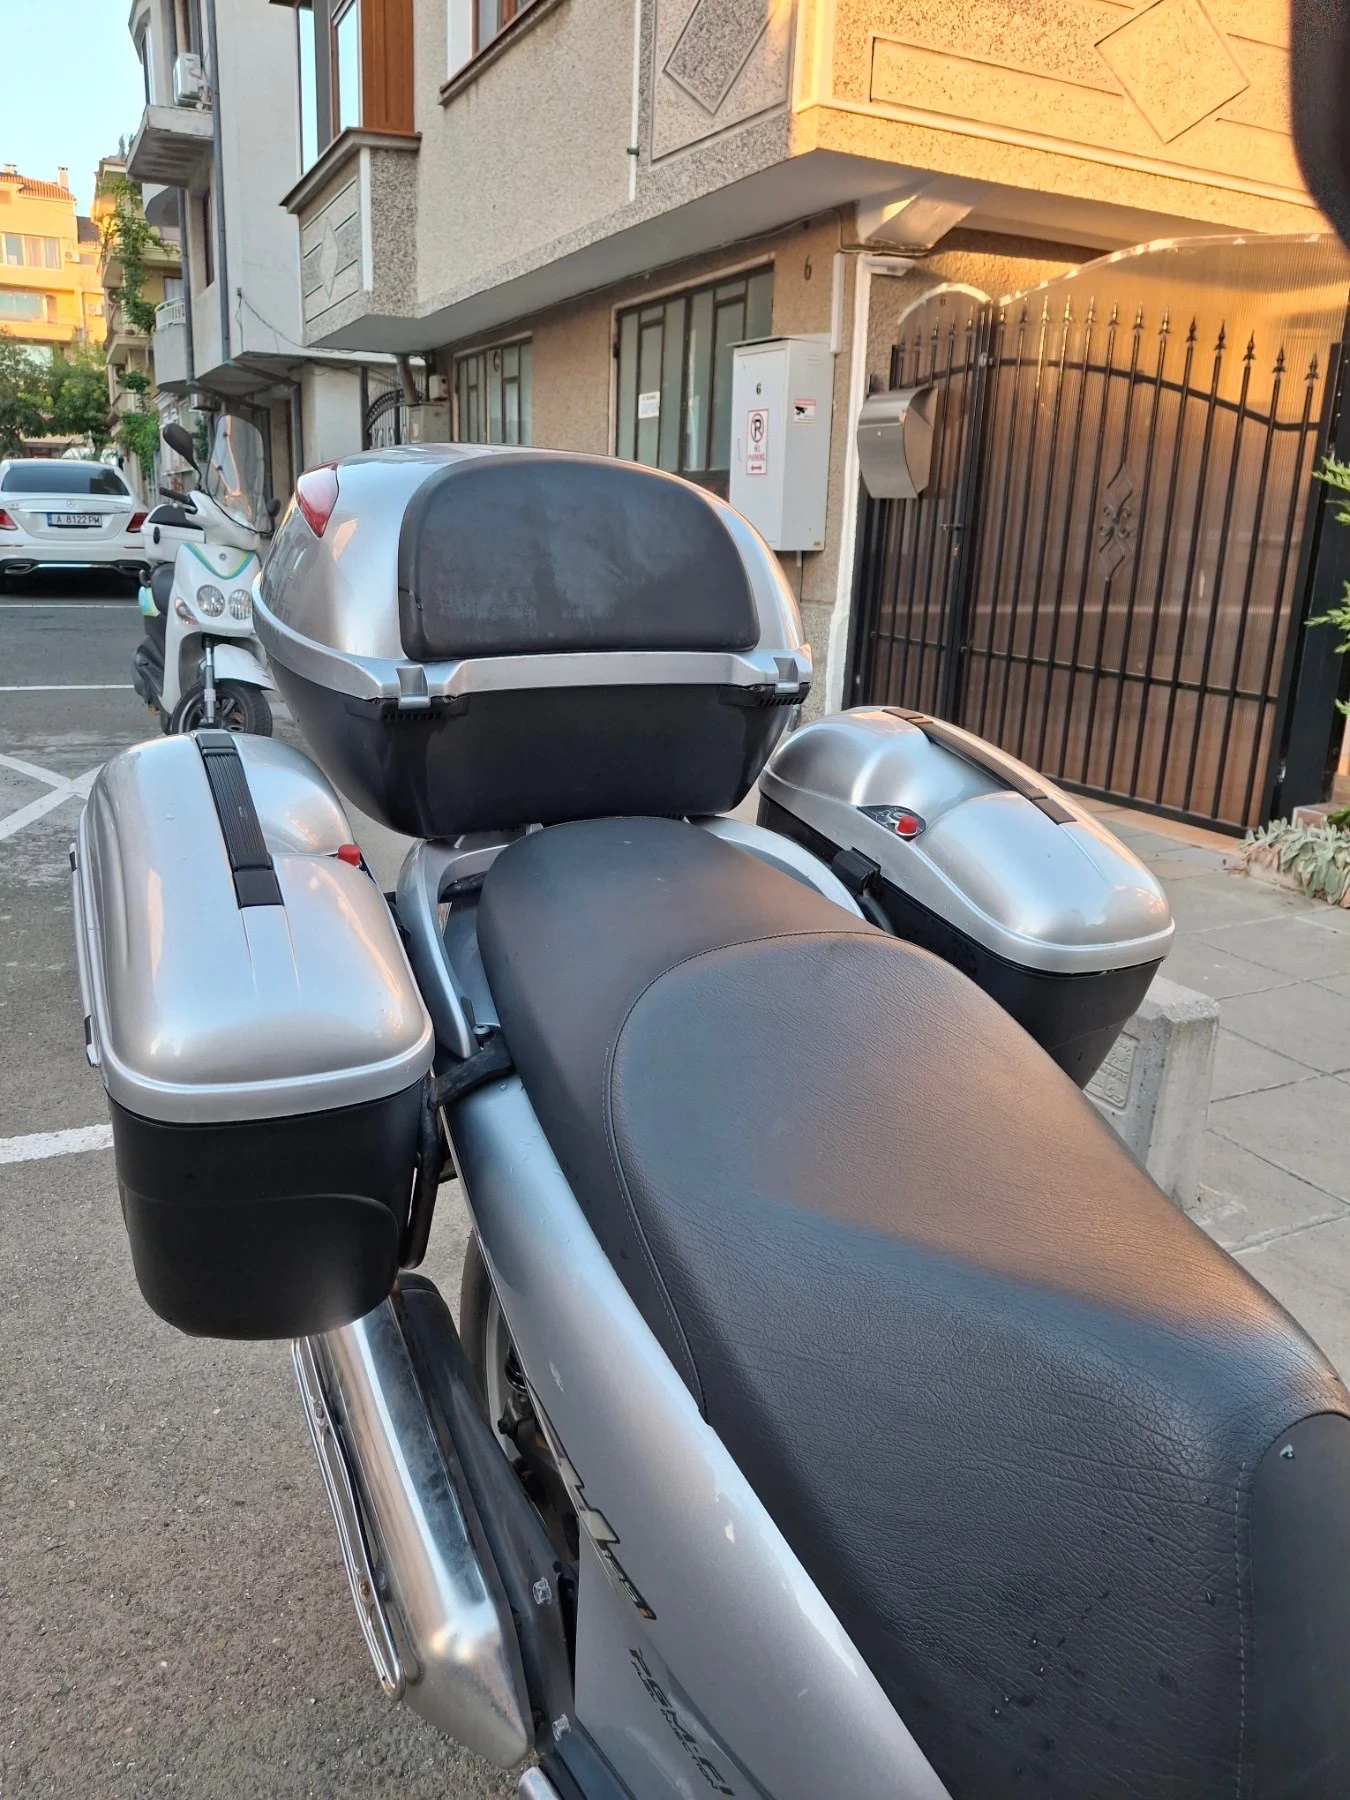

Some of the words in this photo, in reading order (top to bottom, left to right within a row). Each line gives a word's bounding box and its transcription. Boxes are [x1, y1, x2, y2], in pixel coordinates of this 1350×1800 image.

[804, 254, 812, 281] 6
[756, 383, 762, 395] 6
[629, 1648, 735, 1796] PGM-FI
[630, 1660, 657, 1703] FUEL
[660, 1708, 718, 1790] INJECTION
